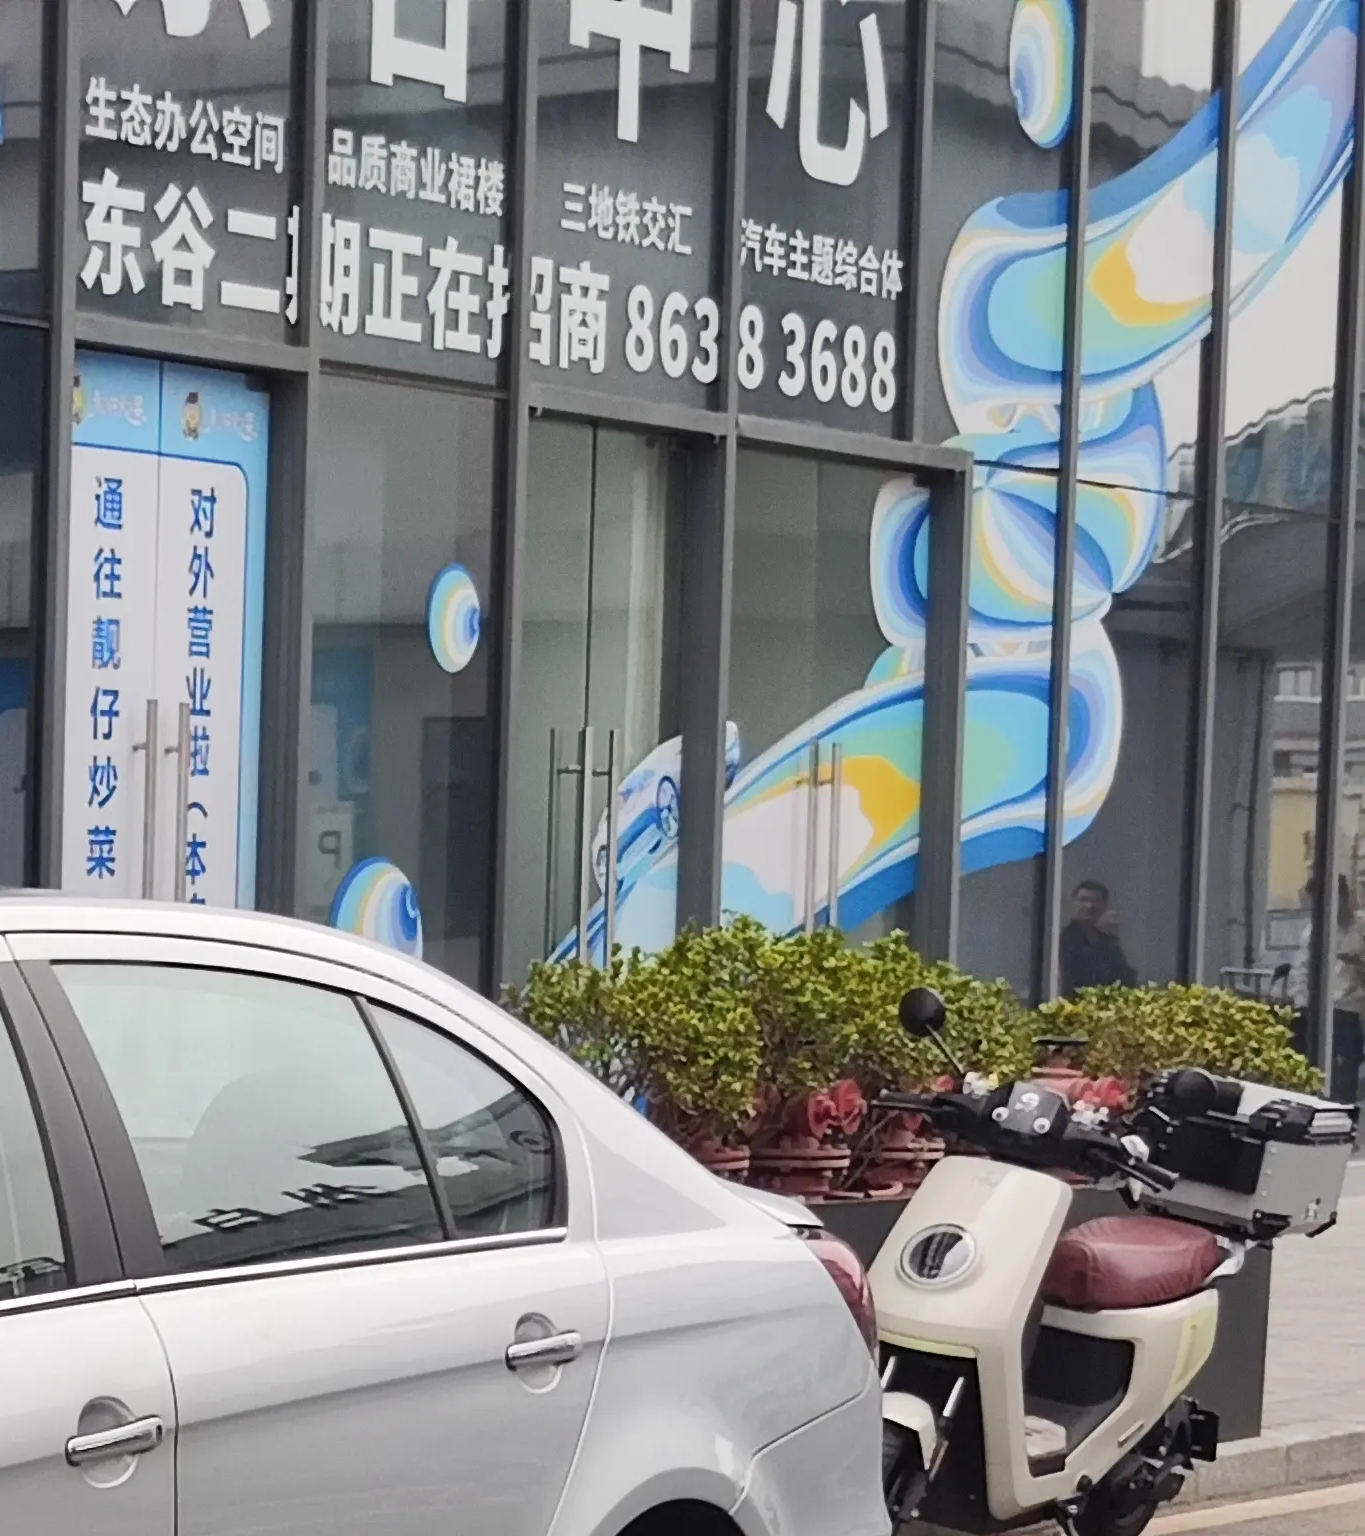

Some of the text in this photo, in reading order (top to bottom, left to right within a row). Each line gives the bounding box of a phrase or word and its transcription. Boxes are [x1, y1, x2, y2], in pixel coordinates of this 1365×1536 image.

[84, 76, 904, 301] 生态办公空间 品质商业裙楼 三地铁交汇 汽车主题综合体
[113, 0, 891, 188] 中心
[625, 284, 765, 391] 8638
[777, 312, 897, 413] 3688
[85, 475, 125, 880] 通往靓仔炒菜
